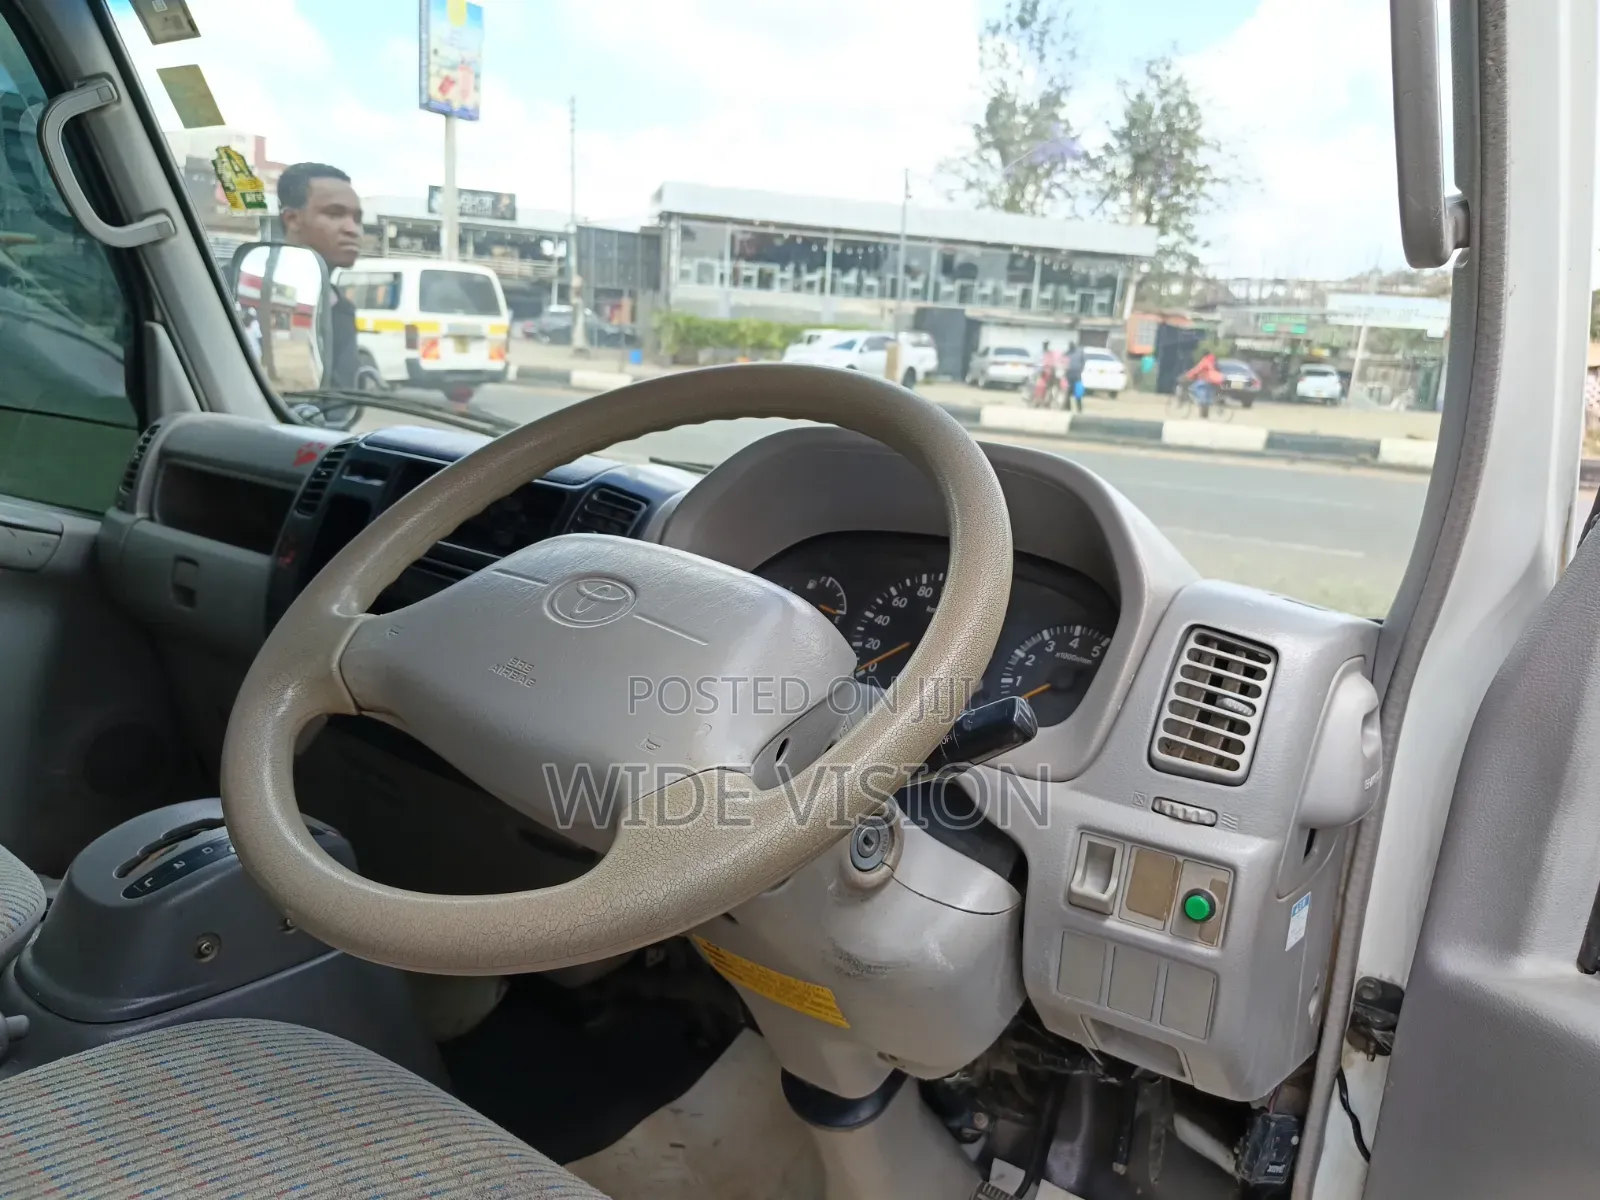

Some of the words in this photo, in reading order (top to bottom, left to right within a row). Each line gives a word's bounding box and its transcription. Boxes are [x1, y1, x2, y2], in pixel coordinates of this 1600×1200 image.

[820, 576, 828, 584] F
[917, 586, 933, 598] 80
[892, 597, 908, 608] 60
[834, 616, 840, 624] E
[874, 615, 890, 626] 40
[865, 637, 881, 650] 20
[1045, 640, 1056, 652] 3
[1069, 637, 1080, 649] 4
[1091, 645, 1102, 658] 5
[1025, 654, 1036, 666] 2
[868, 661, 877, 673] 0
[487, 663, 536, 689] AIRBAG
[1015, 675, 1022, 687] 1
[201, 846, 214, 855] D
[173, 860, 186, 869] 2
